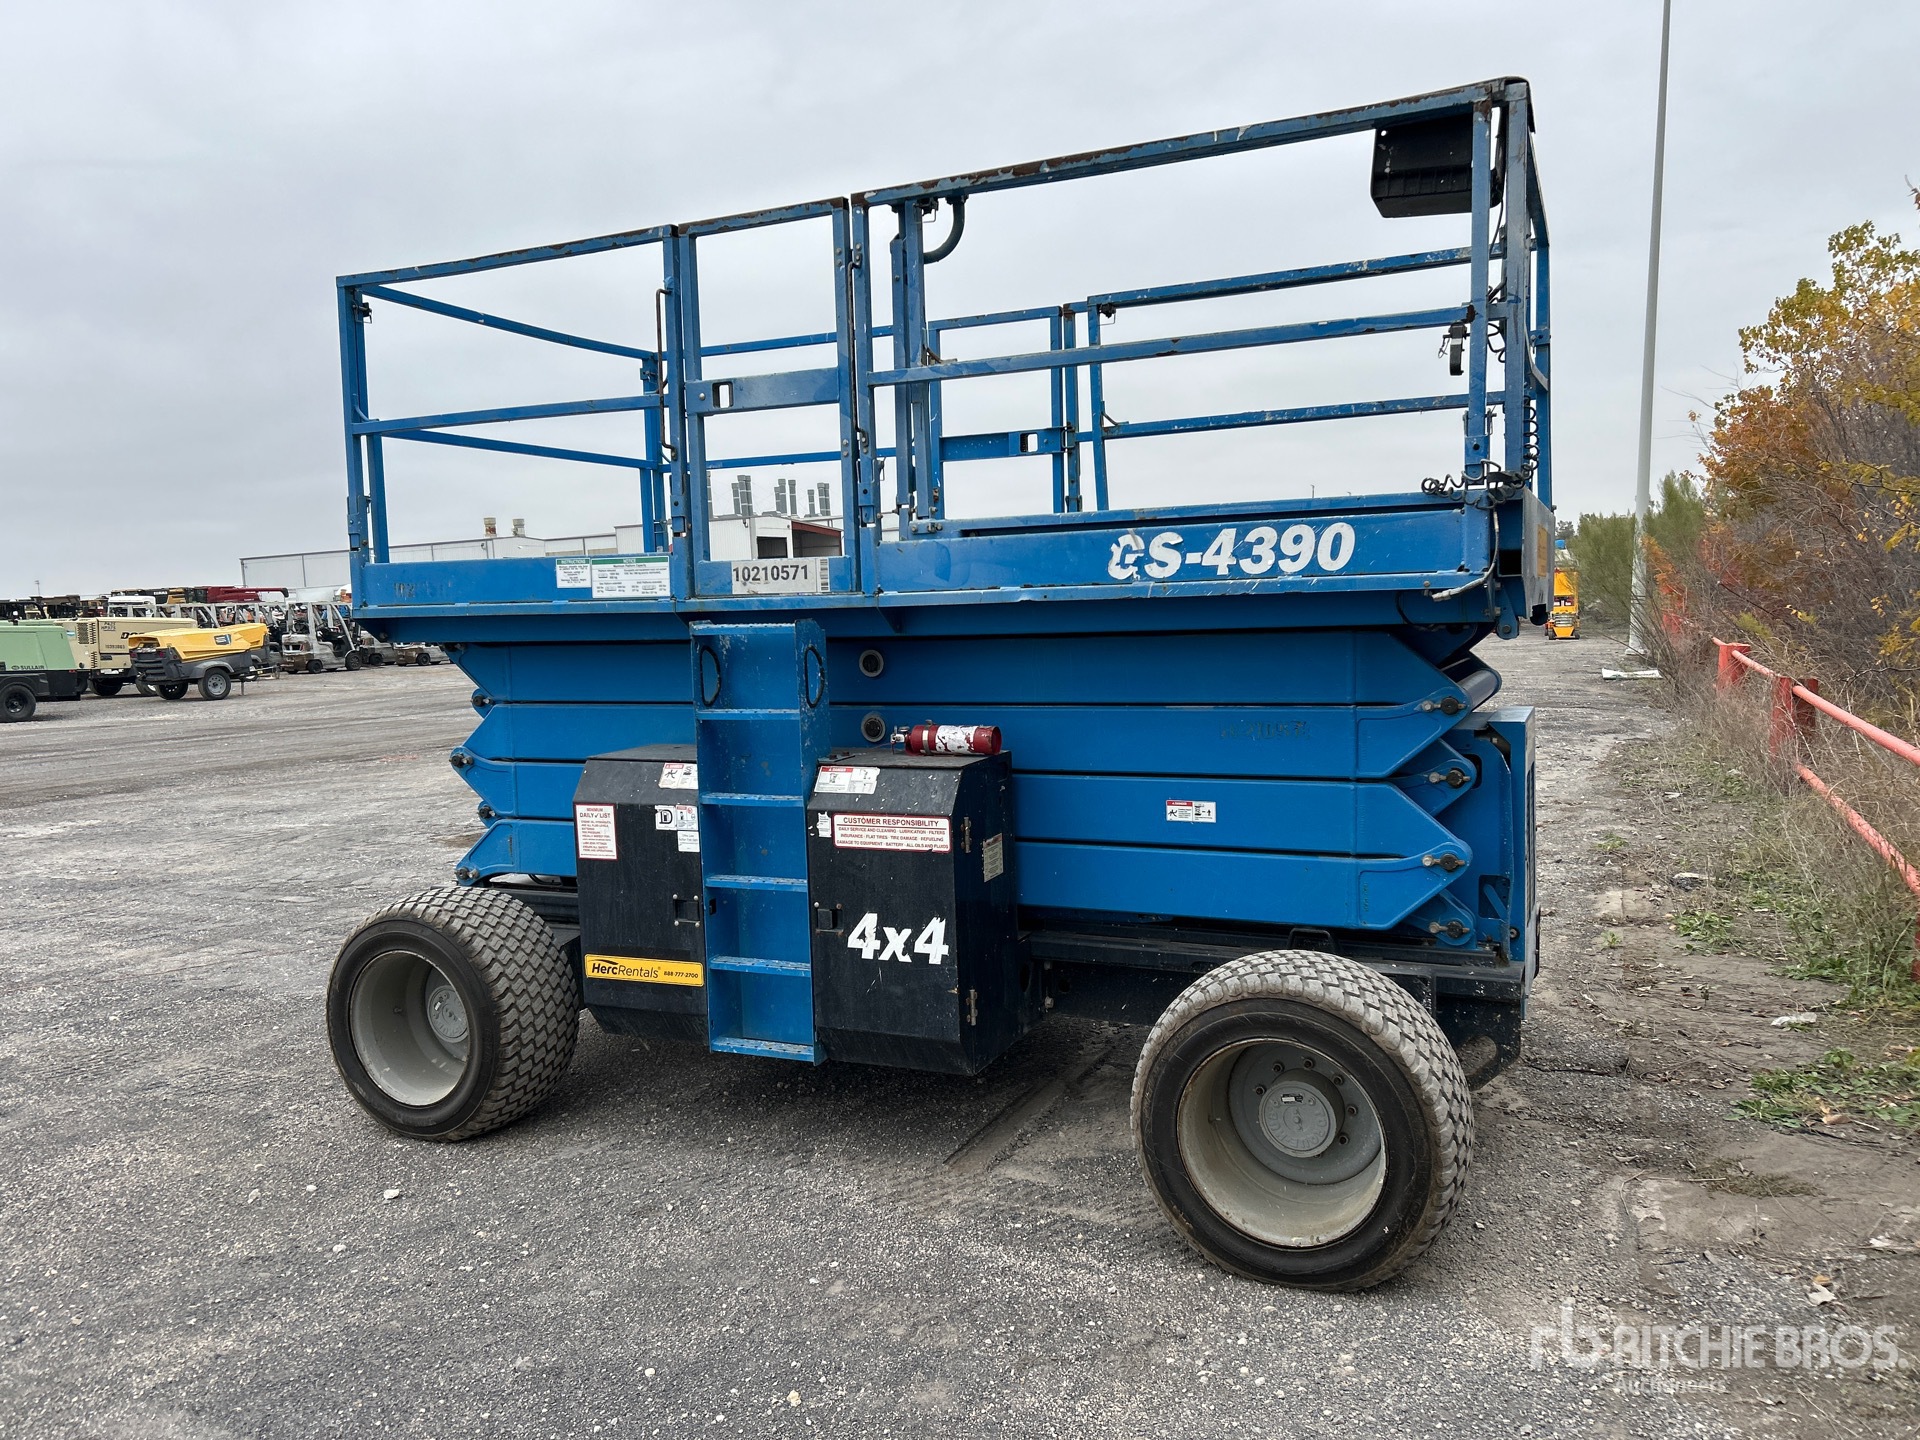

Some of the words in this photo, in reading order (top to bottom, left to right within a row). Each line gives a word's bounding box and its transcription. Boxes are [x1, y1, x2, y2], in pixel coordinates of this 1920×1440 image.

[1107, 522, 1356, 580] GS-4390
[733, 564, 808, 582] 10210571
[843, 817, 881, 825] CUSTOMER
[883, 819, 939, 827] RESPONSIBILITY
[847, 912, 950, 965] 4x4
[592, 962, 659, 979] HercRentals
